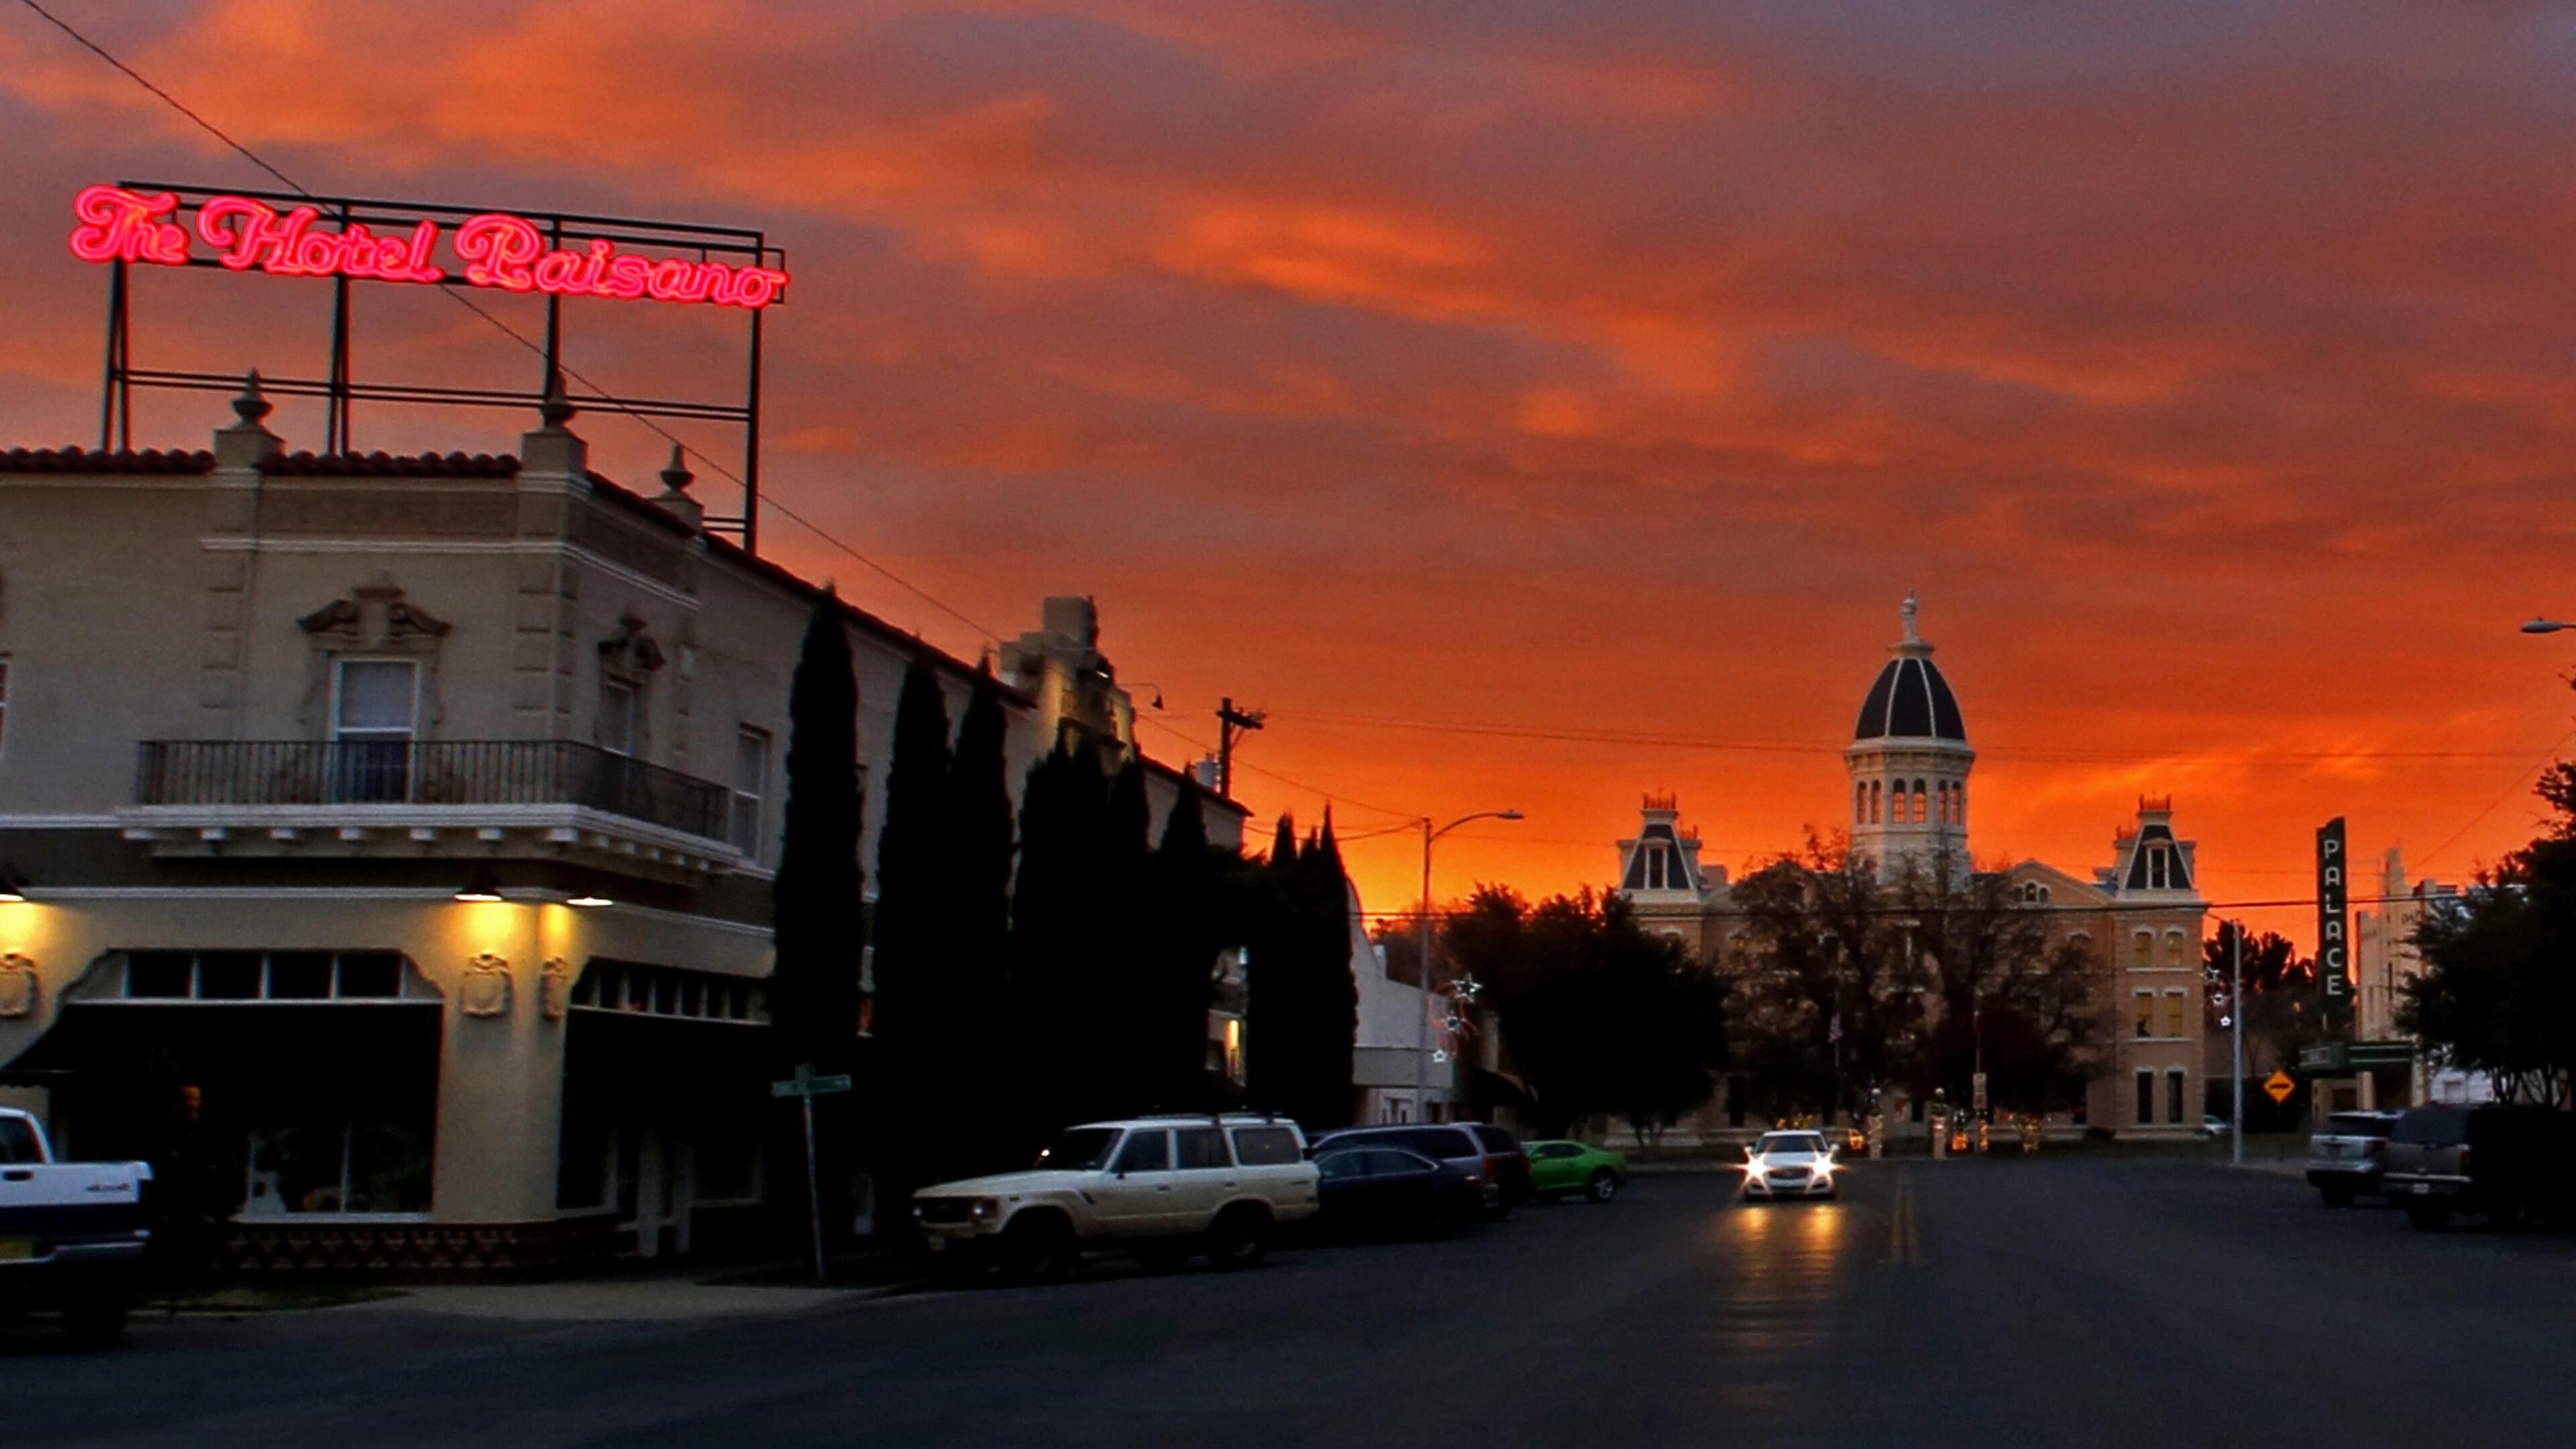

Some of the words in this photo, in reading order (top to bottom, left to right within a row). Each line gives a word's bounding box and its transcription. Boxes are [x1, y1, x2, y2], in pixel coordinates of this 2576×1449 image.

[70, 184, 189, 262] The
[197, 195, 444, 283] Hotel
[453, 213, 791, 308] Paisano
[2323, 839, 2343, 996] PALACE
